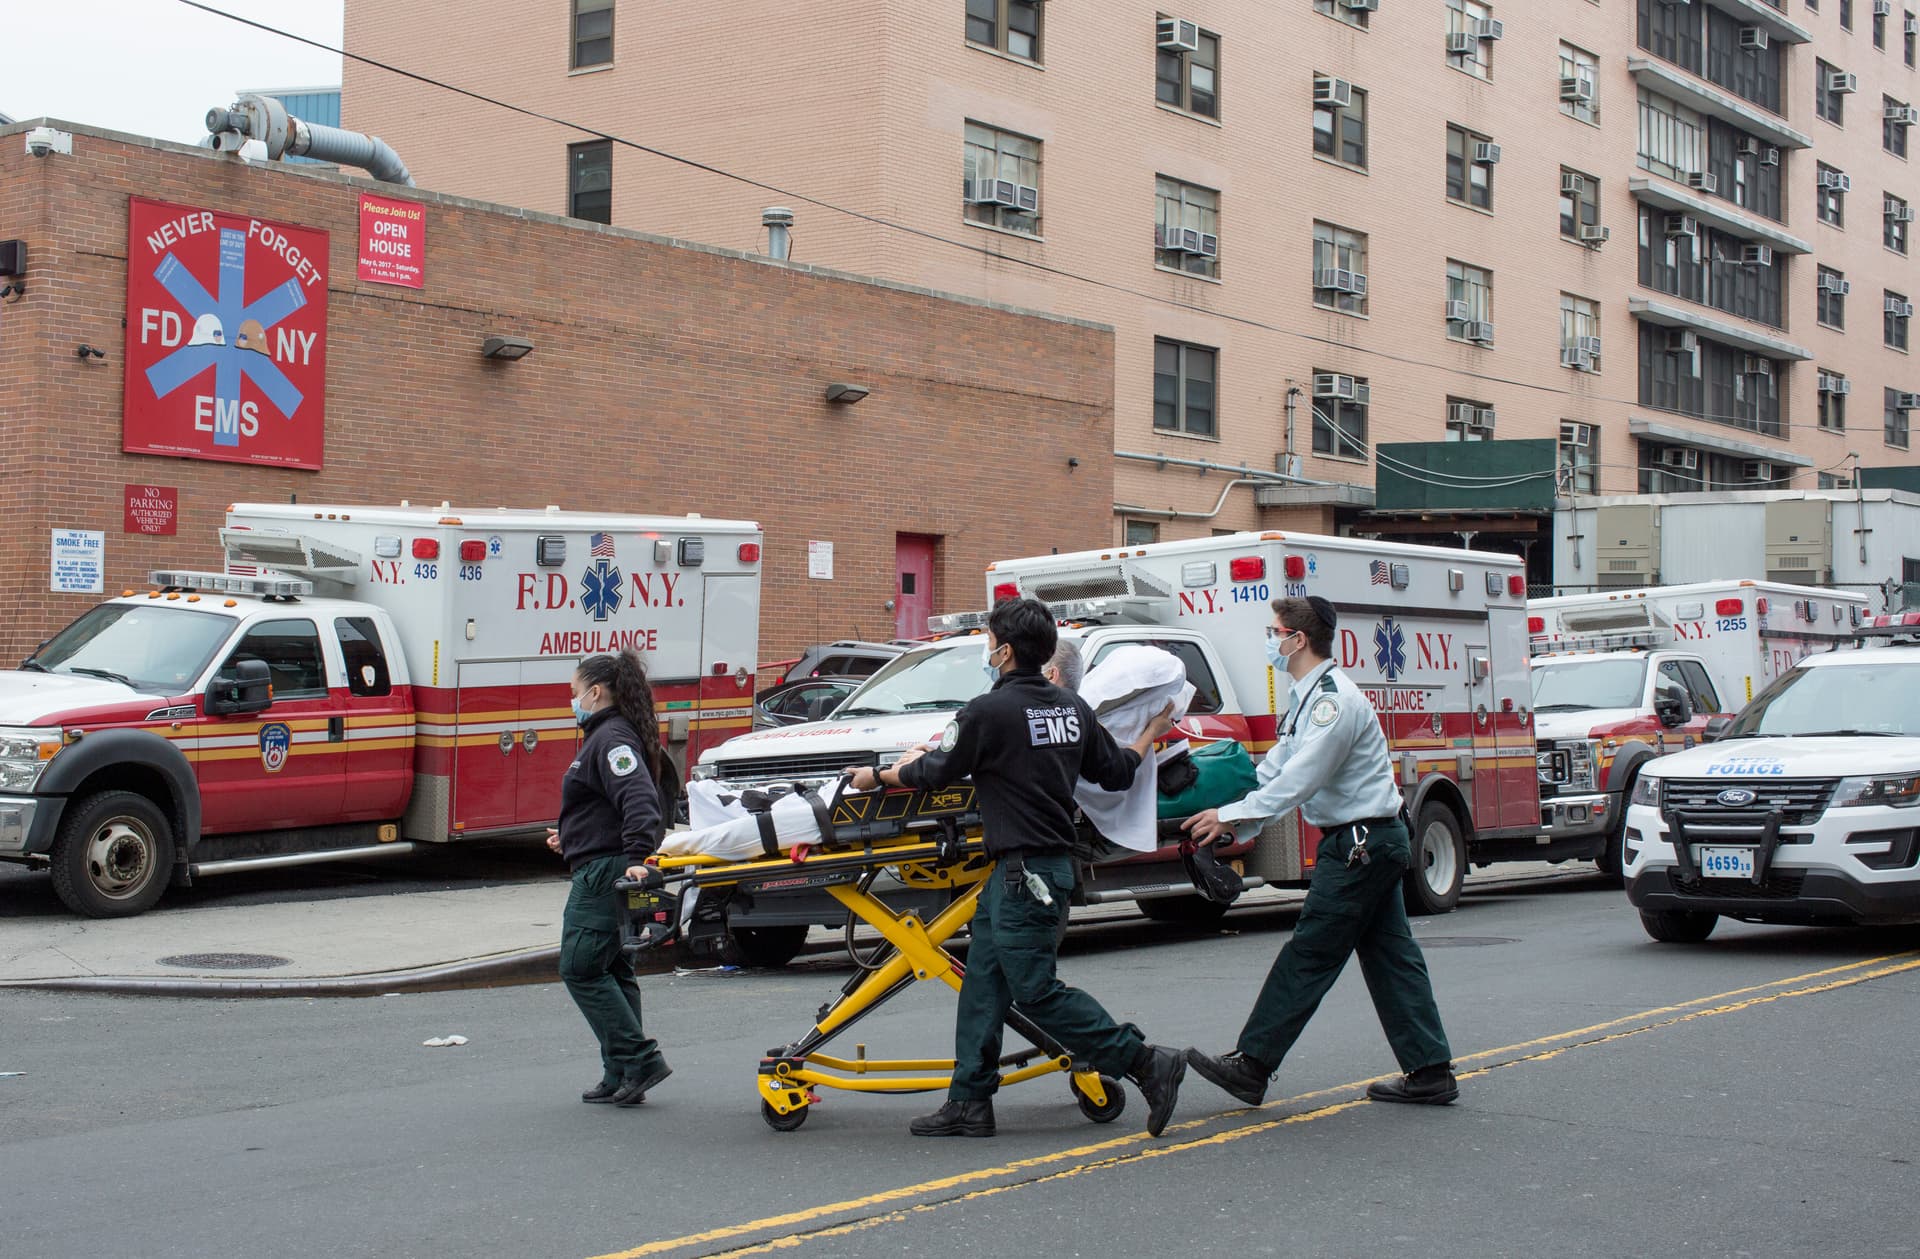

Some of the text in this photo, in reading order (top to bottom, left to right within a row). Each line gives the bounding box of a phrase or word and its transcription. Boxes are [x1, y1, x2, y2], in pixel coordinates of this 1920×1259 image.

[363, 201, 421, 220] Please Join Us!
[374, 220, 407, 238] OPEN
[146, 211, 321, 287] NEVER FORGET
[369, 238, 411, 257] HOUSE
[361, 258, 372, 267] May
[378, 261, 391, 269] 2017
[141, 307, 317, 365] FD NY
[195, 395, 259, 437] EMS
[144, 487, 160, 497] NO
[130, 498, 173, 510] PARKING
[131, 509, 172, 519] AUTHORIZED
[136, 517, 167, 525] VEHICLES
[141, 524, 161, 532] ONLY!
[56, 538, 99, 548] SMOKE FREE
[370, 560, 438, 585] N.Y. 436
[459, 565, 483, 581] 436
[516, 573, 684, 610] F.D. N.Y.
[1284, 583, 1307, 597] 1410
[1178, 584, 1269, 616] N.Y. 1410
[1673, 617, 1747, 641] N.Y. 1255
[539, 628, 657, 655] AMBULANCE
[1416, 632, 1458, 670] N.Y.
[1361, 690, 1424, 711] BULANCE
[1027, 716, 1081, 746] EMS
[1706, 764, 1785, 775] POLICE
[931, 793, 962, 805] XPS
[1722, 791, 1745, 802] Ford
[1706, 855, 1739, 871] 4659
